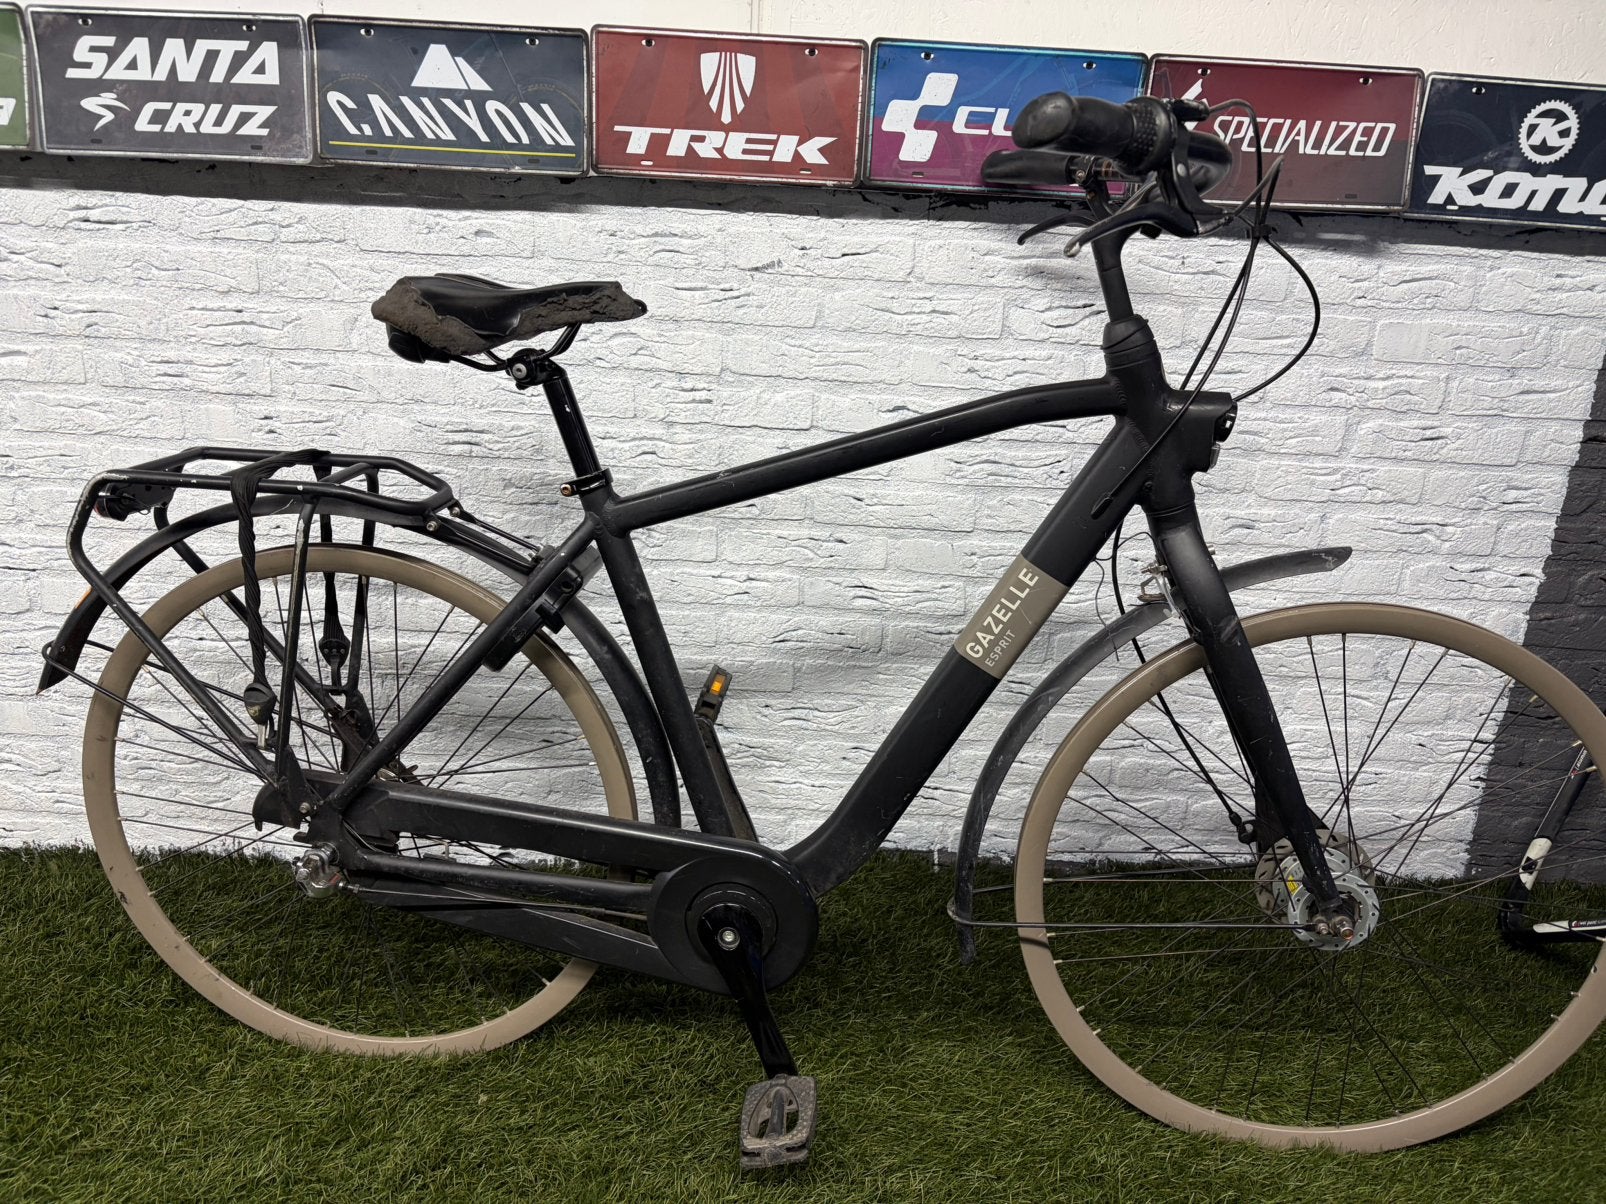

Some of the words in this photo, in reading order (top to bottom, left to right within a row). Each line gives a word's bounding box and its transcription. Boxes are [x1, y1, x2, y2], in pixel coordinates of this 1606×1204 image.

[65, 35, 281, 86] SANTA
[134, 101, 278, 137] CRUZ
[326, 90, 576, 147] CANYON
[1213, 115, 1397, 157] SPECIALIZED
[613, 125, 838, 165] TREK
[965, 567, 1040, 659] GAZELLE
[985, 629, 1016, 668] ESPRIT
